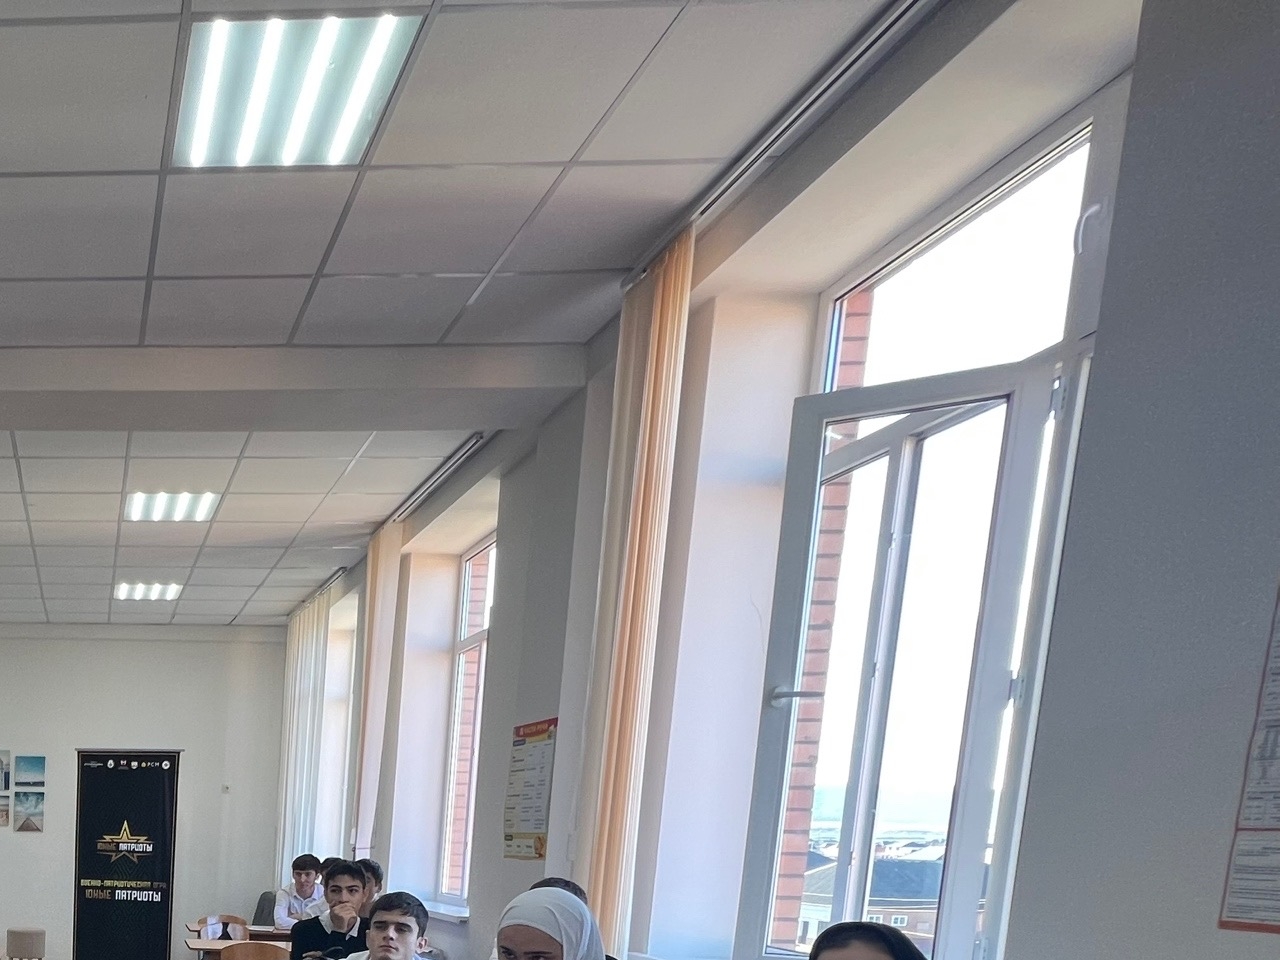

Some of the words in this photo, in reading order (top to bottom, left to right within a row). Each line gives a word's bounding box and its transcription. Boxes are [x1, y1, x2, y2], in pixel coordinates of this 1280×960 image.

[119, 843, 153, 852] ПАТРИОТЫ
[85, 889, 112, 900] ЮНЫЕ
[115, 890, 161, 902] ПАТРИОТЫ
